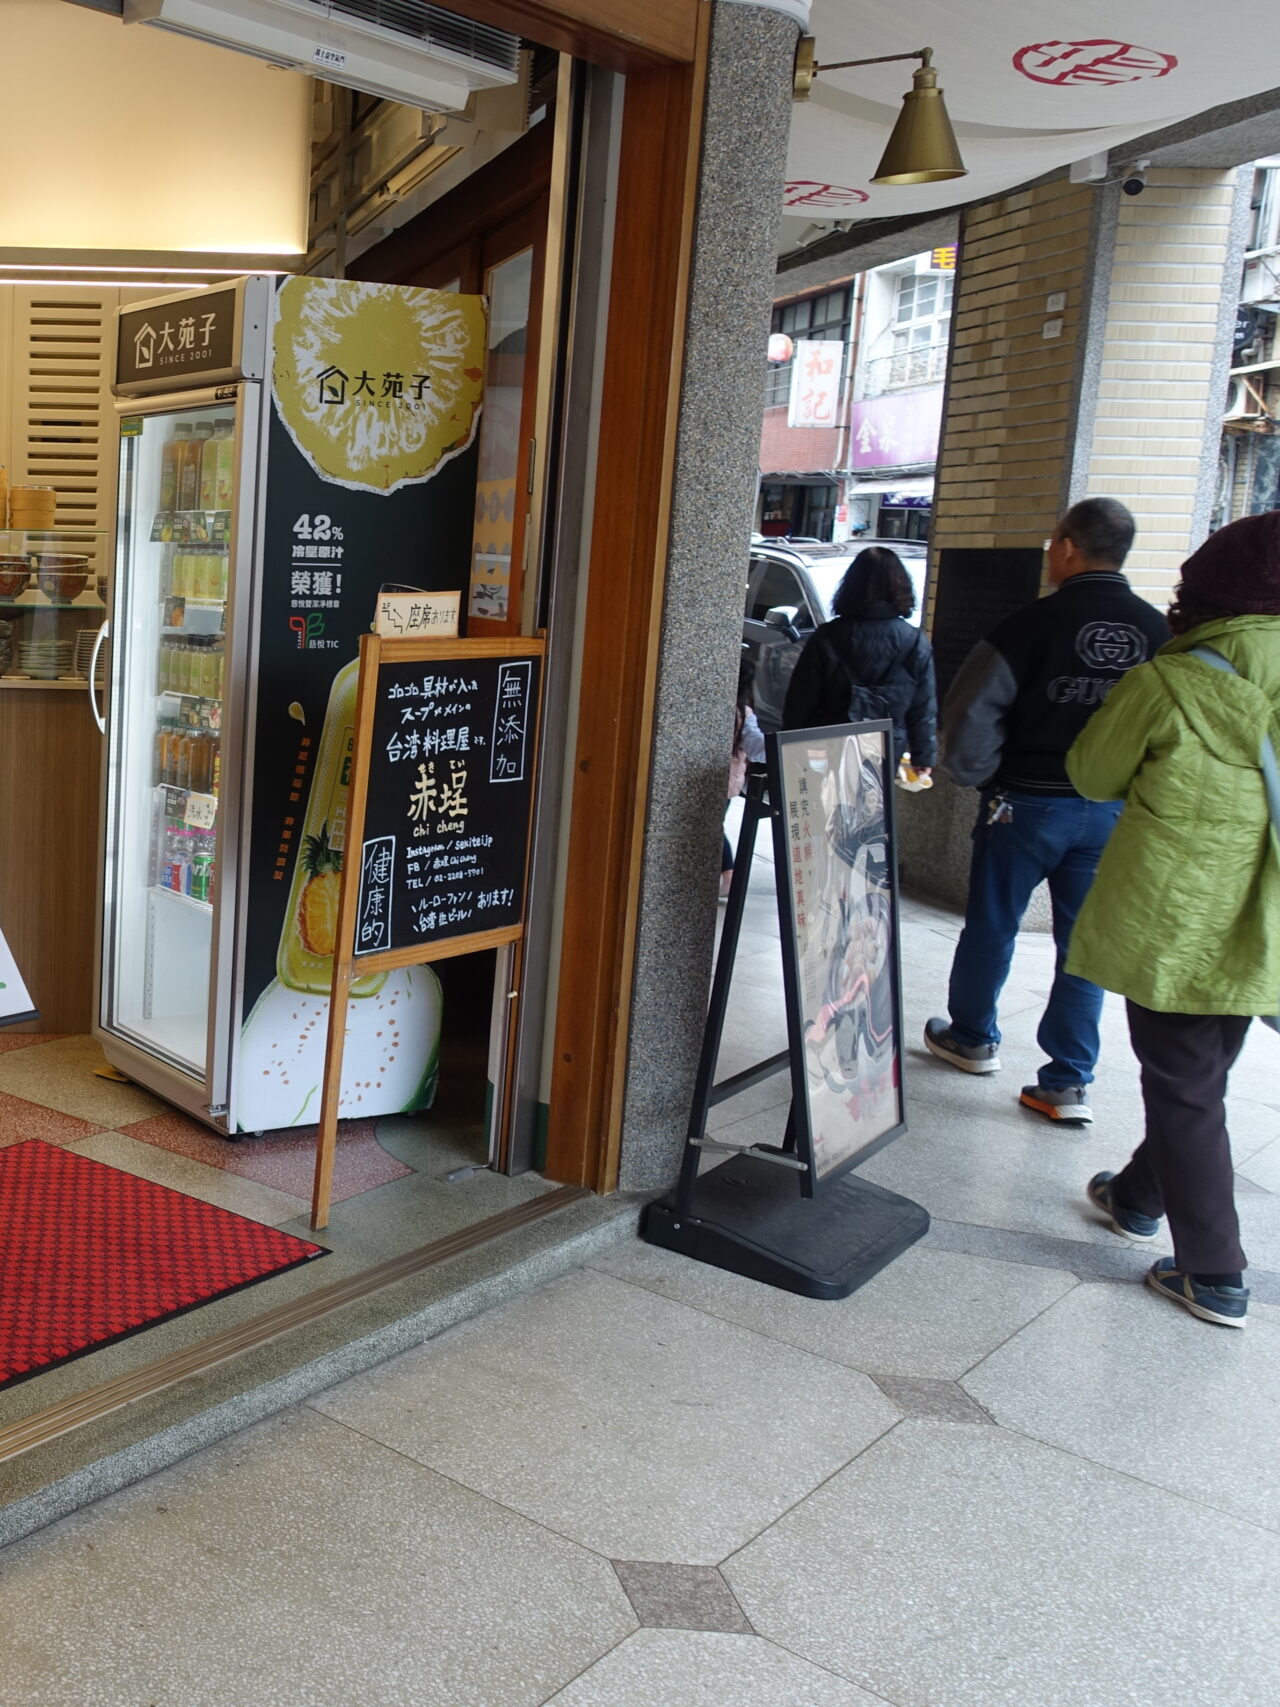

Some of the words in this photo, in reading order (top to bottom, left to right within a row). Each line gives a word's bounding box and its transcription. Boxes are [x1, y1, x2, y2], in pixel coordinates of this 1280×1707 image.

[158, 312, 216, 354] 大苑子
[159, 353, 185, 365] SINCE
[190, 349, 212, 361] 2001
[354, 370, 431, 400] 大苑子
[802, 350, 835, 422] 和記
[356, 400, 391, 409] SINCE
[398, 402, 427, 410] 2001
[293, 513, 344, 541] 42%
[292, 545, 344, 558] 冷壓原汁
[326, 640, 339, 648] TIC
[388, 676, 478, 699] ゴロゴロ具材が入った
[401, 702, 471, 724] スープがメインの
[496, 670, 524, 777] 無添加
[407, 770, 469, 821] 赤埕
[413, 823, 429, 837] chi
[437, 820, 465, 834] cheng
[407, 844, 445, 859] Instagram
[408, 863, 419, 875] FB
[407, 879, 423, 889] TEL
[362, 844, 392, 947] 健康的
